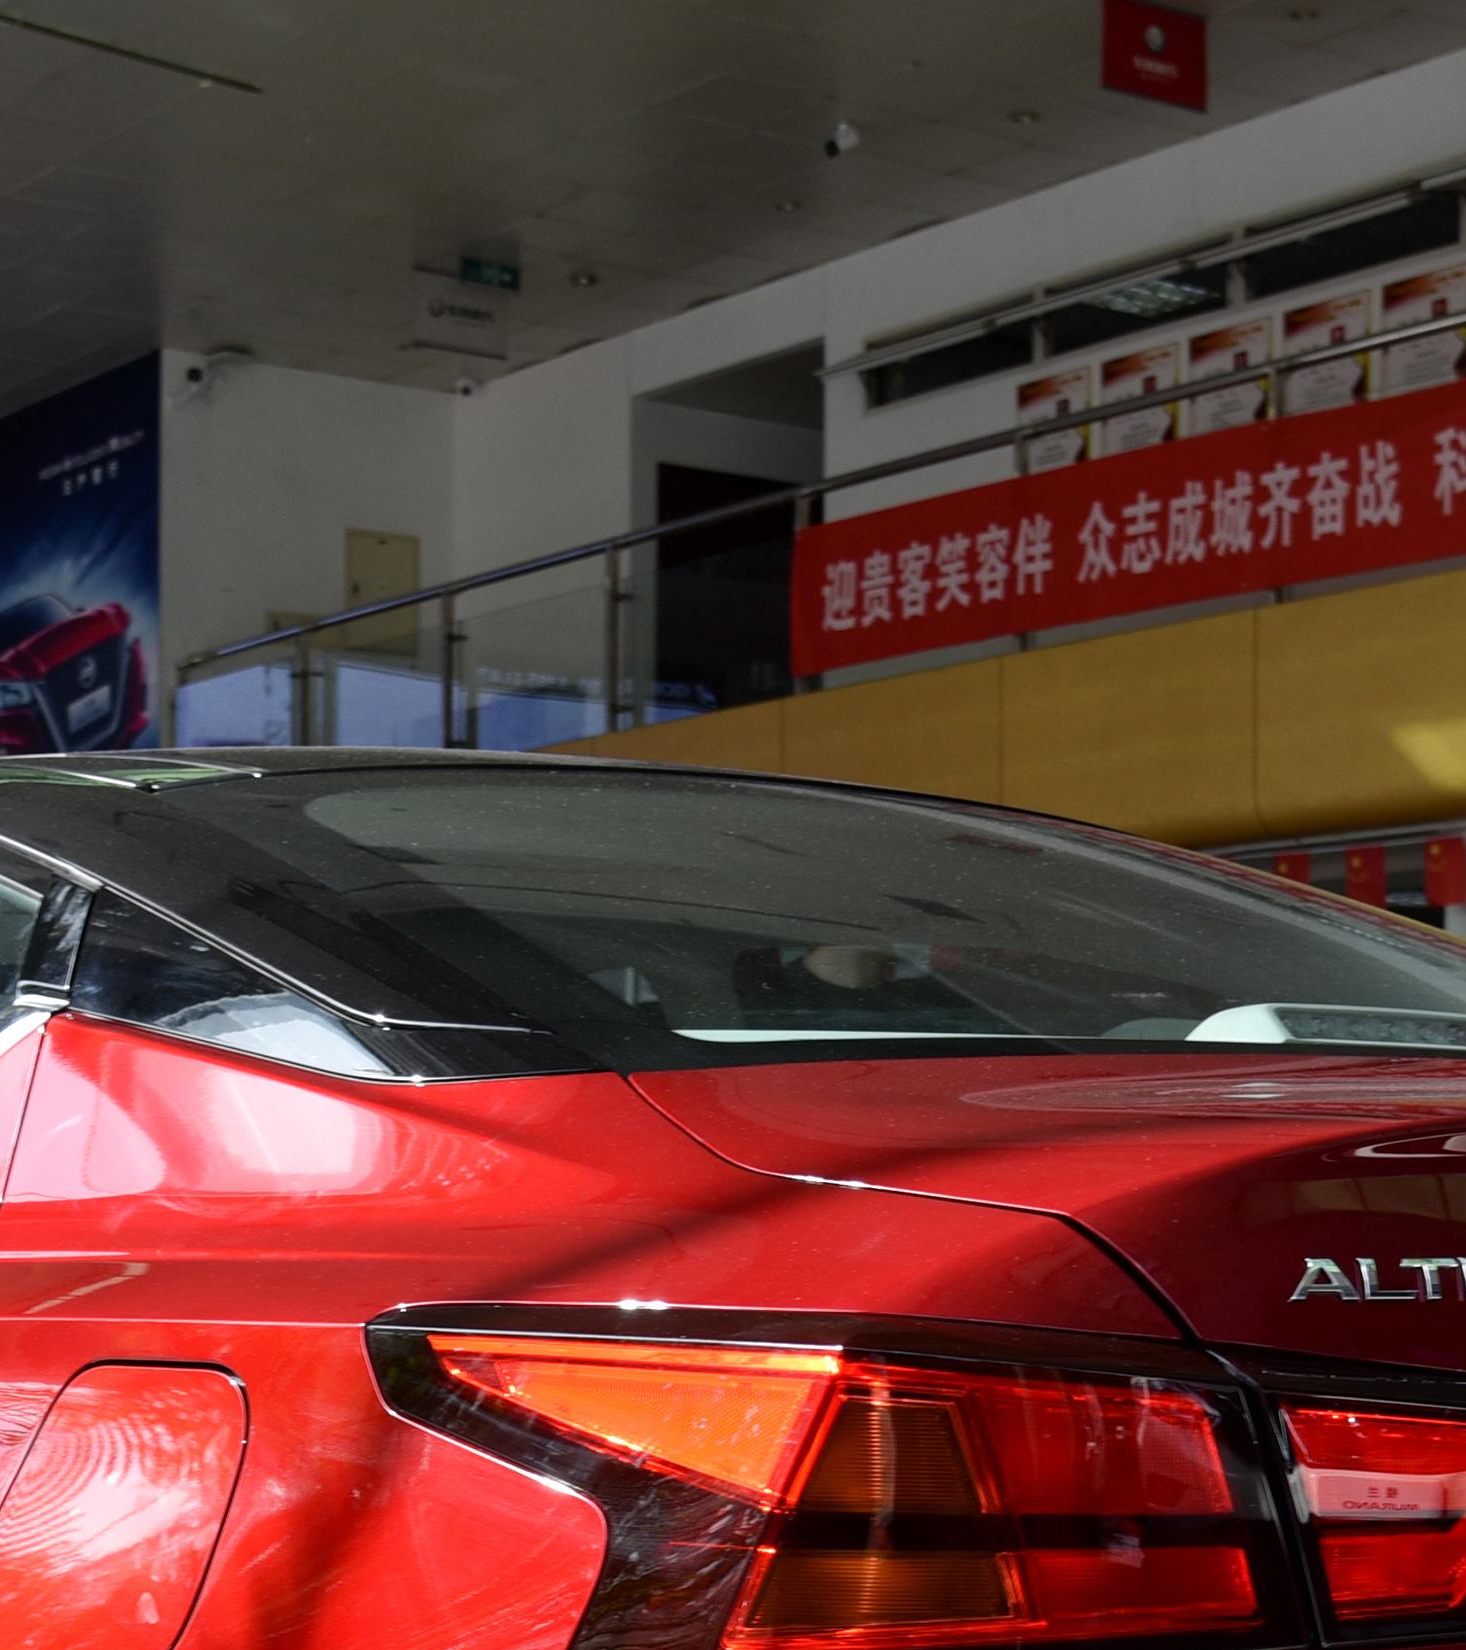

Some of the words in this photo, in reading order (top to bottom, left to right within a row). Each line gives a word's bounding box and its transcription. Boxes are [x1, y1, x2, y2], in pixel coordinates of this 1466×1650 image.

[822, 513, 1054, 631] 迎贵客笑容伴
[1077, 443, 1402, 583] 众志成城齐奋战
